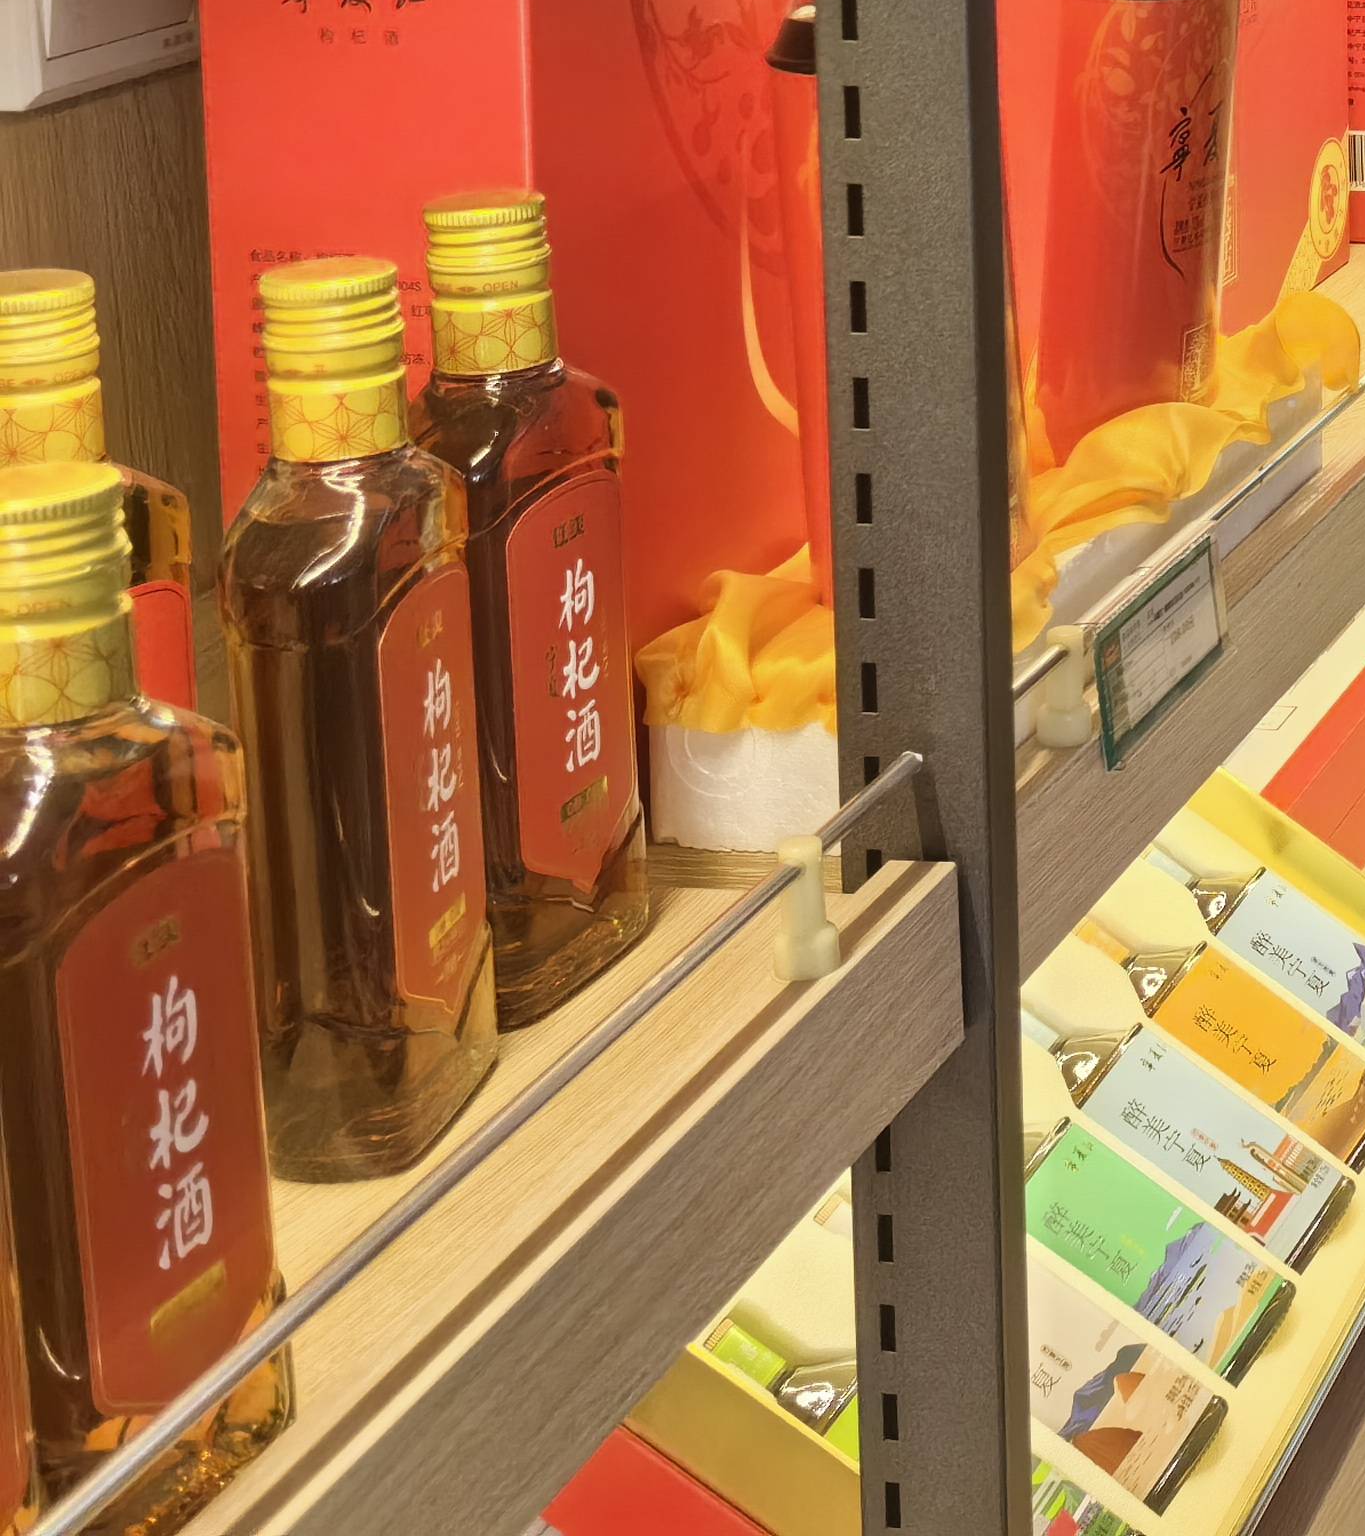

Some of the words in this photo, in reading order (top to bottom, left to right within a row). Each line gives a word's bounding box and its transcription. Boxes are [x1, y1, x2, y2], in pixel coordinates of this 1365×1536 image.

[319, 27, 400, 47] 枸杞酒
[482, 280, 520, 294] OPEN
[558, 558, 602, 773] 枸杞酒
[423, 658, 462, 894] 枸杞酒
[1249, 929, 1331, 999] 醉美宁夏
[1192, 1004, 1278, 1076] 醉美宁夏
[141, 975, 215, 1270] 枸杞酒
[1120, 1098, 1212, 1173] 醉美宁夏
[1041, 1201, 1139, 1289] 醉美宁夏
